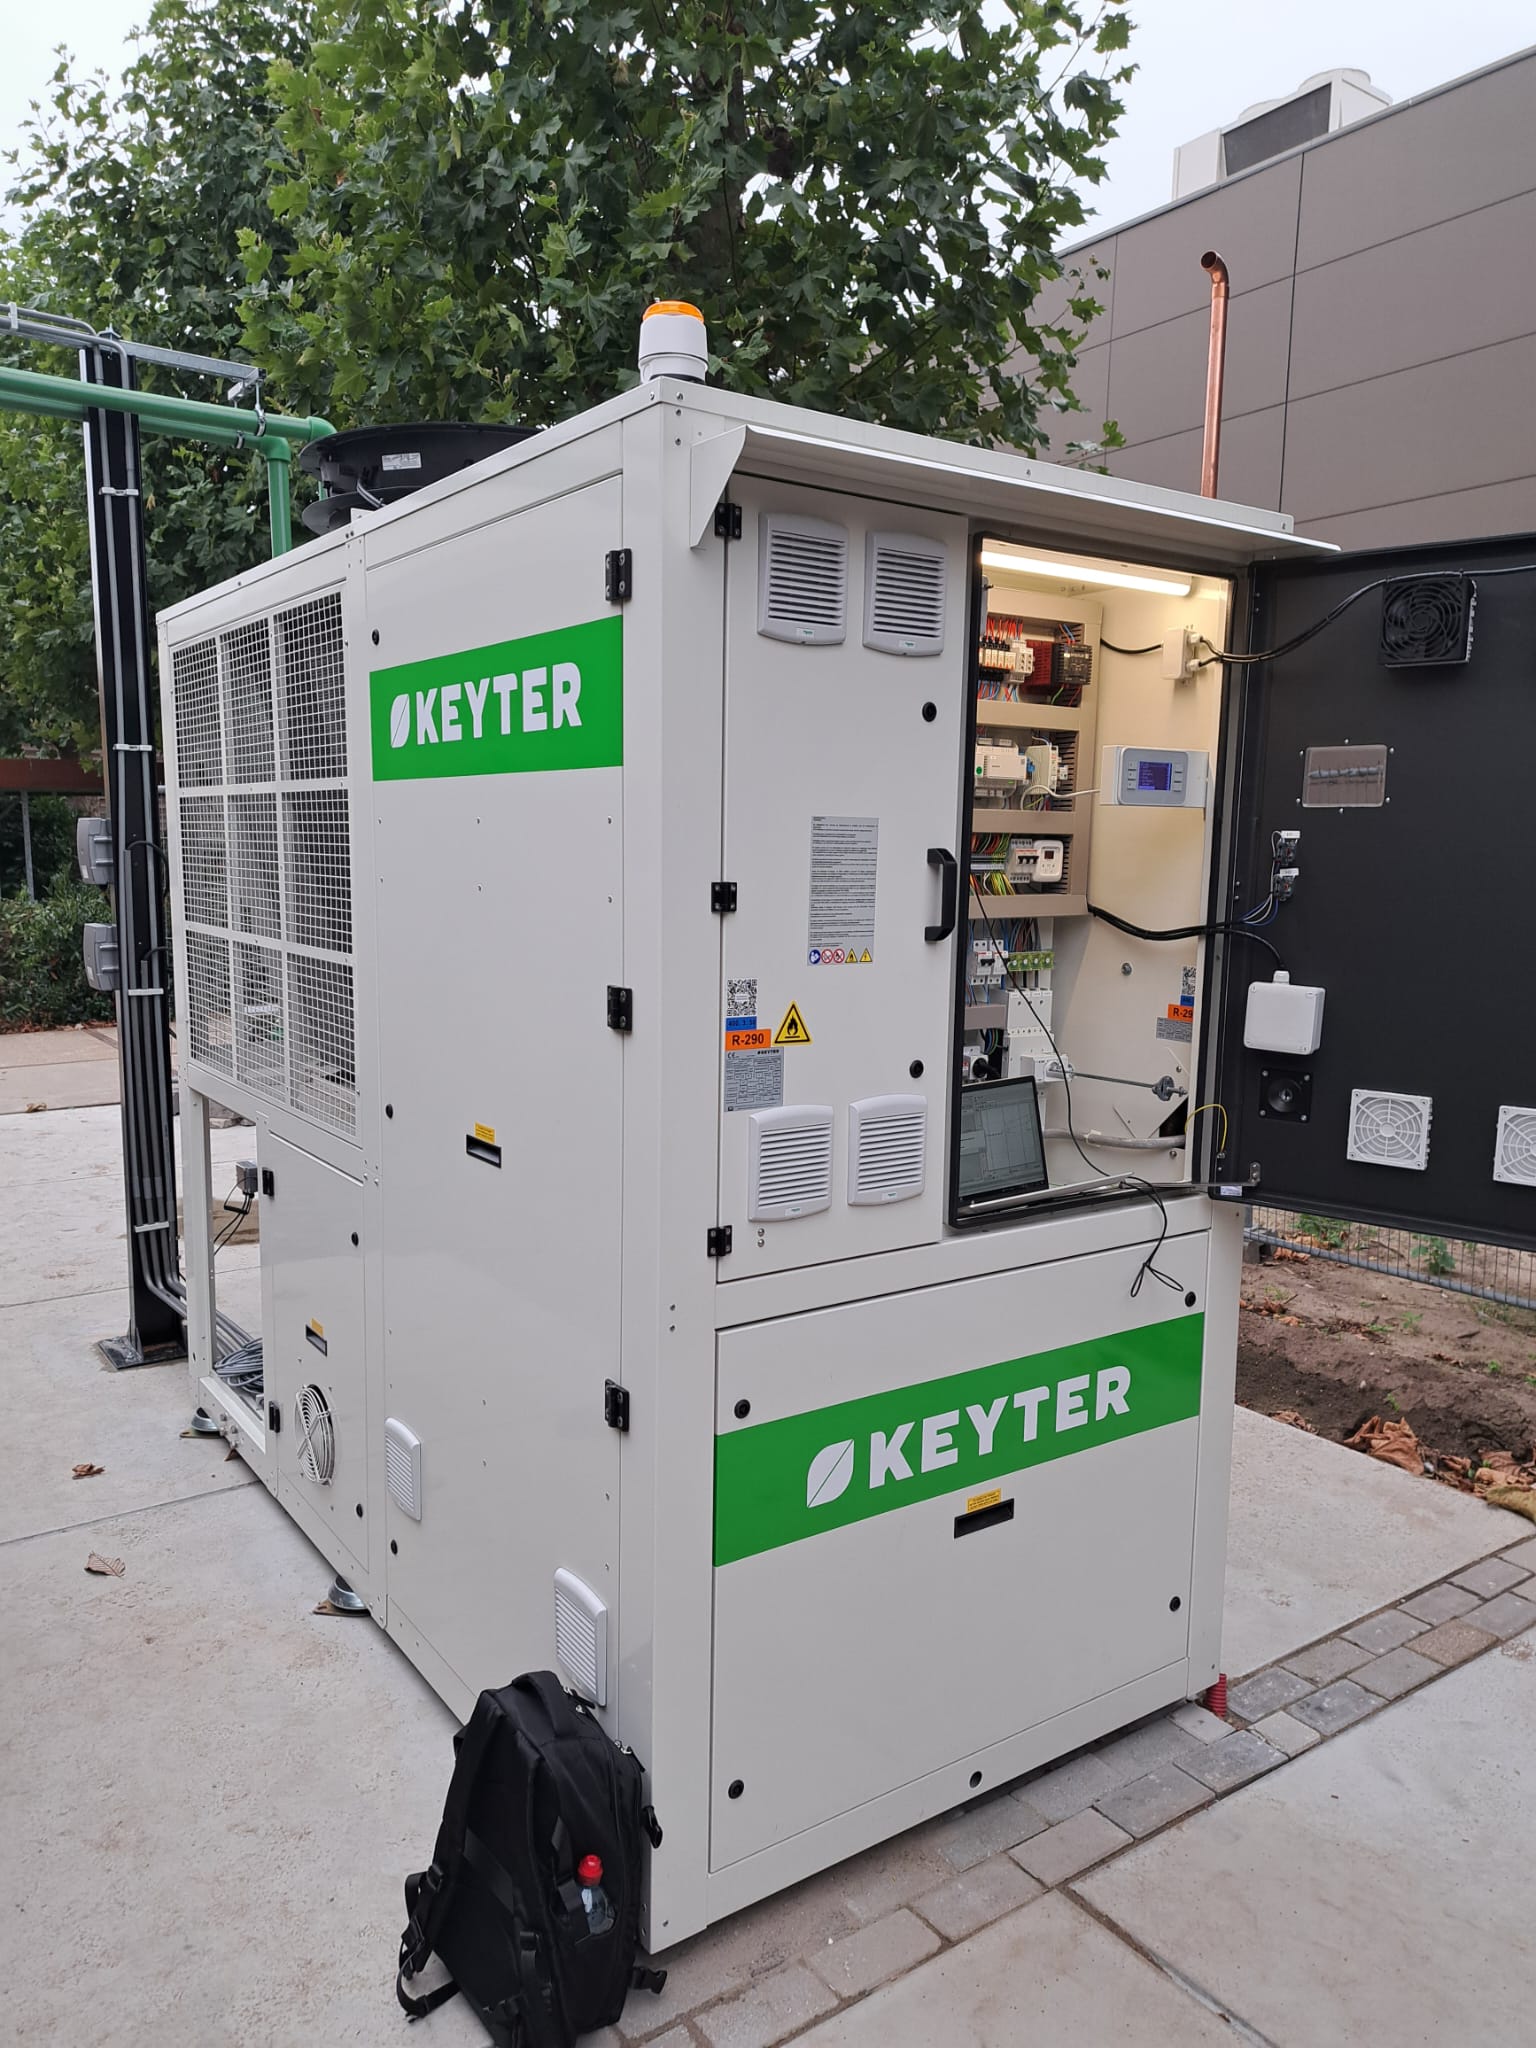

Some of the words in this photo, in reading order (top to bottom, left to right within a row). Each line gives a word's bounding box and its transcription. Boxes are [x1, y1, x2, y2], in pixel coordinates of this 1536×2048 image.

[416, 662, 582, 746] KEYTER
[732, 1033, 765, 1046] R-290
[868, 1365, 1131, 1489] KEYTER
